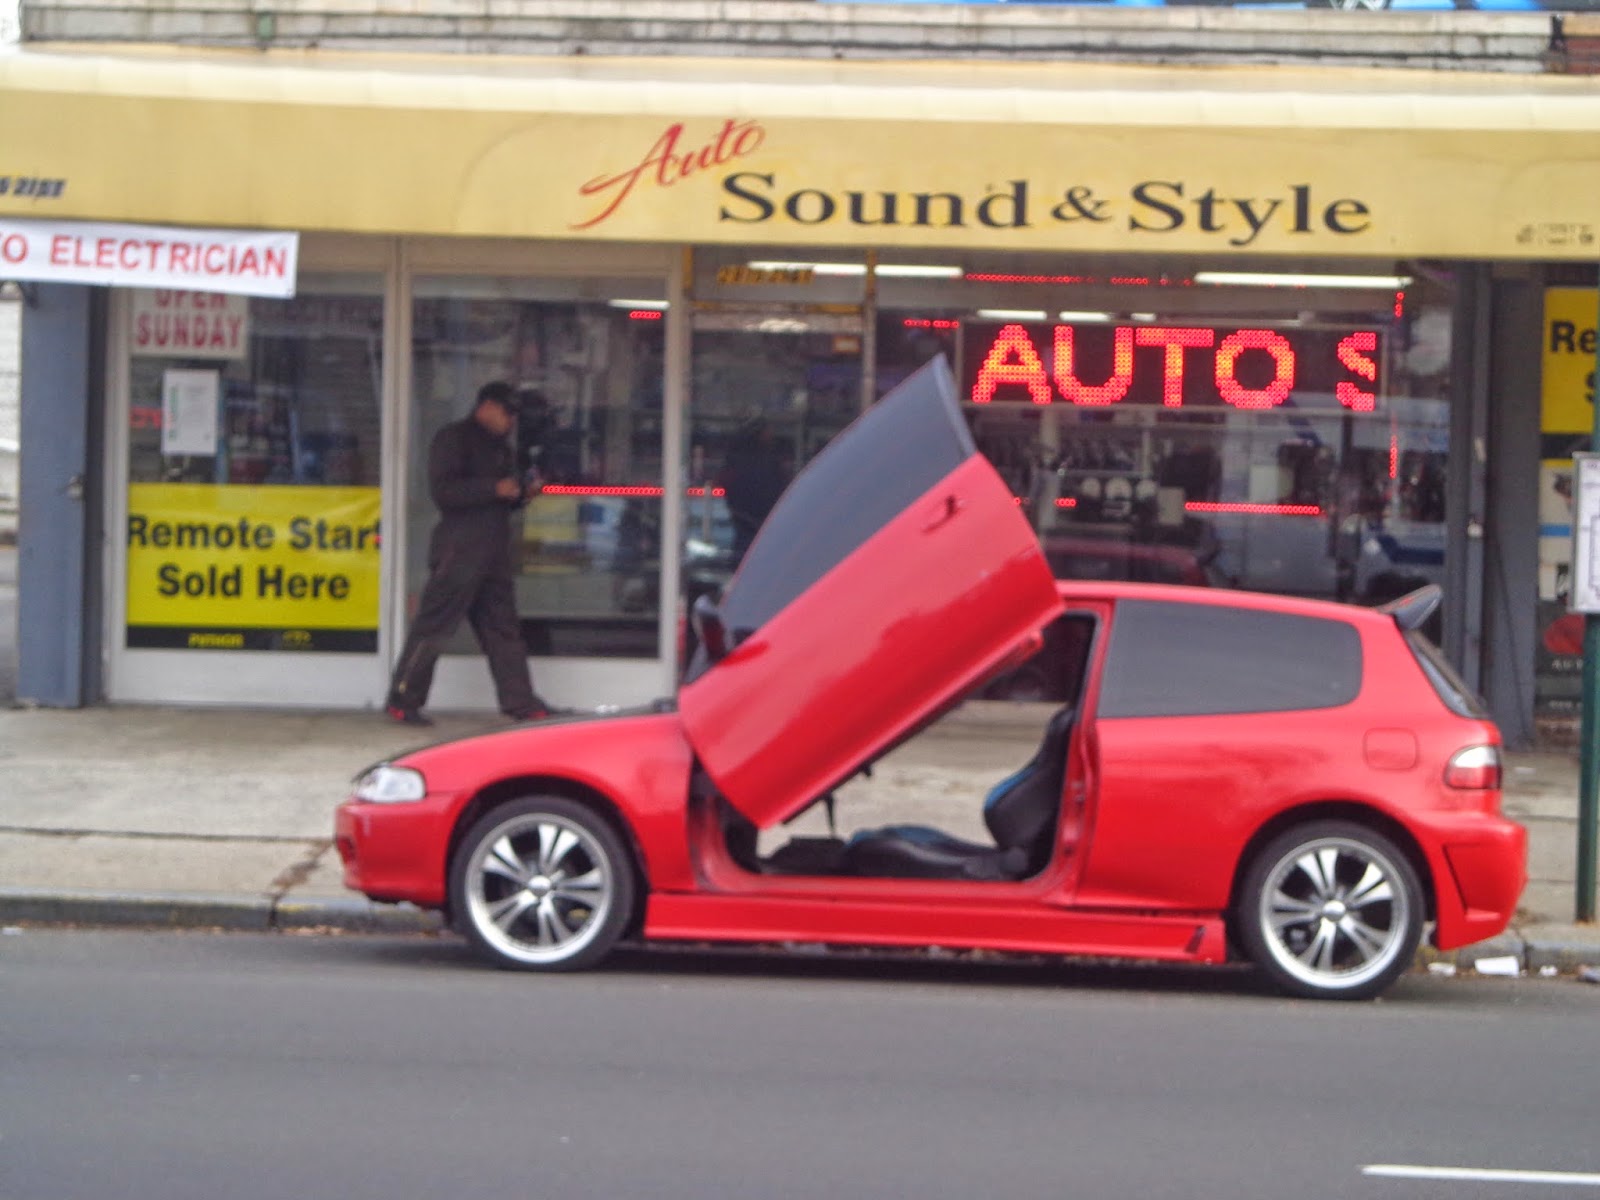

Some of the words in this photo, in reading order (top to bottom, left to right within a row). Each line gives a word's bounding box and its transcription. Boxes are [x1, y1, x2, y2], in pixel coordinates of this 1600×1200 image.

[569, 118, 766, 229] Auto
[719, 173, 1030, 228] Sound
[1052, 185, 1112, 222] &
[1129, 180, 1371, 247] Style
[50, 234, 287, 277] ELECTRICIAN
[136, 313, 243, 349] SUNDAY
[971, 324, 1296, 409] AUTO
[128, 516, 275, 550] Remote
[157, 563, 242, 597] Sold
[258, 565, 351, 599] Here
